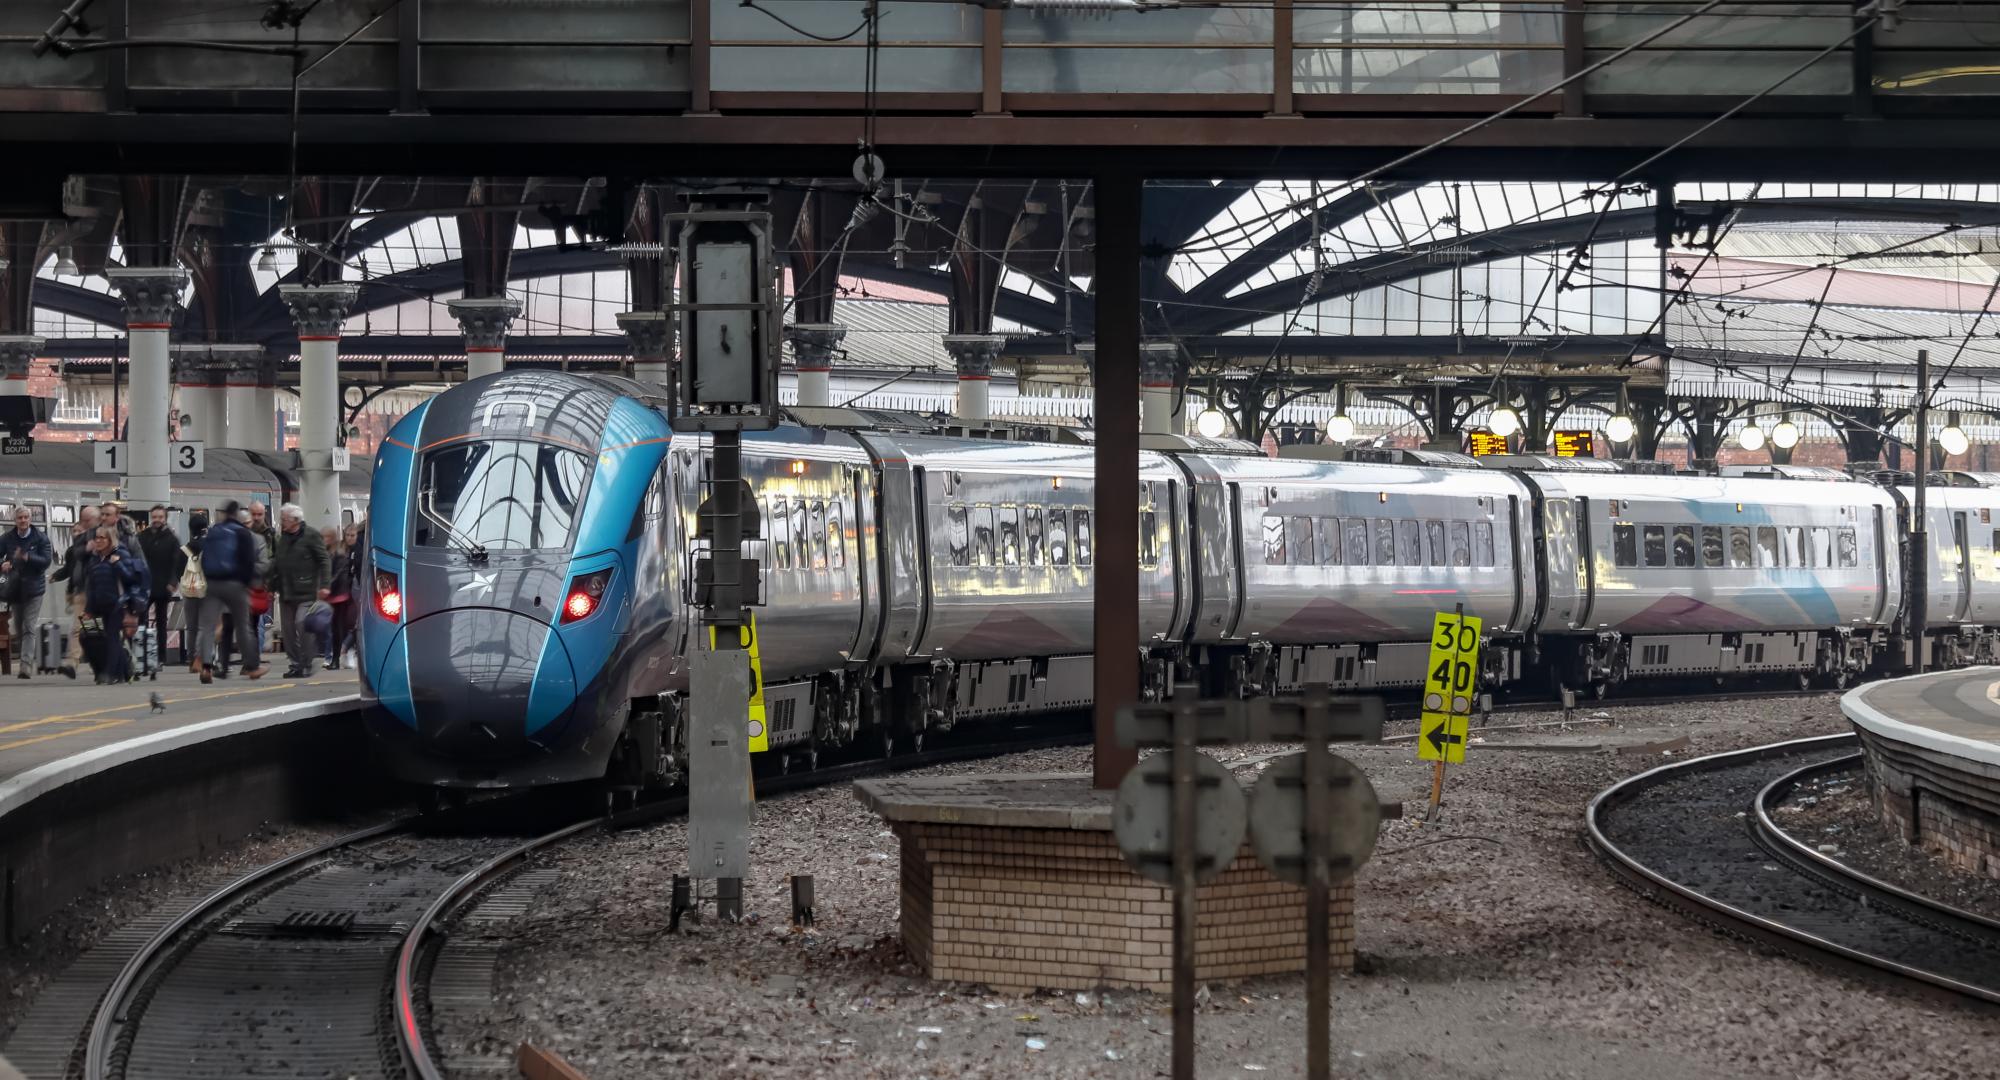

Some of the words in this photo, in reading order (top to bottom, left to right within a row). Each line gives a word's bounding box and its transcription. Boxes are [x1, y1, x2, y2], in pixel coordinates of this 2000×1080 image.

[105, 446, 116, 469] 1
[179, 445, 196, 469] 3
[1435, 621, 1477, 653] 30
[1432, 659, 1471, 692] 40
